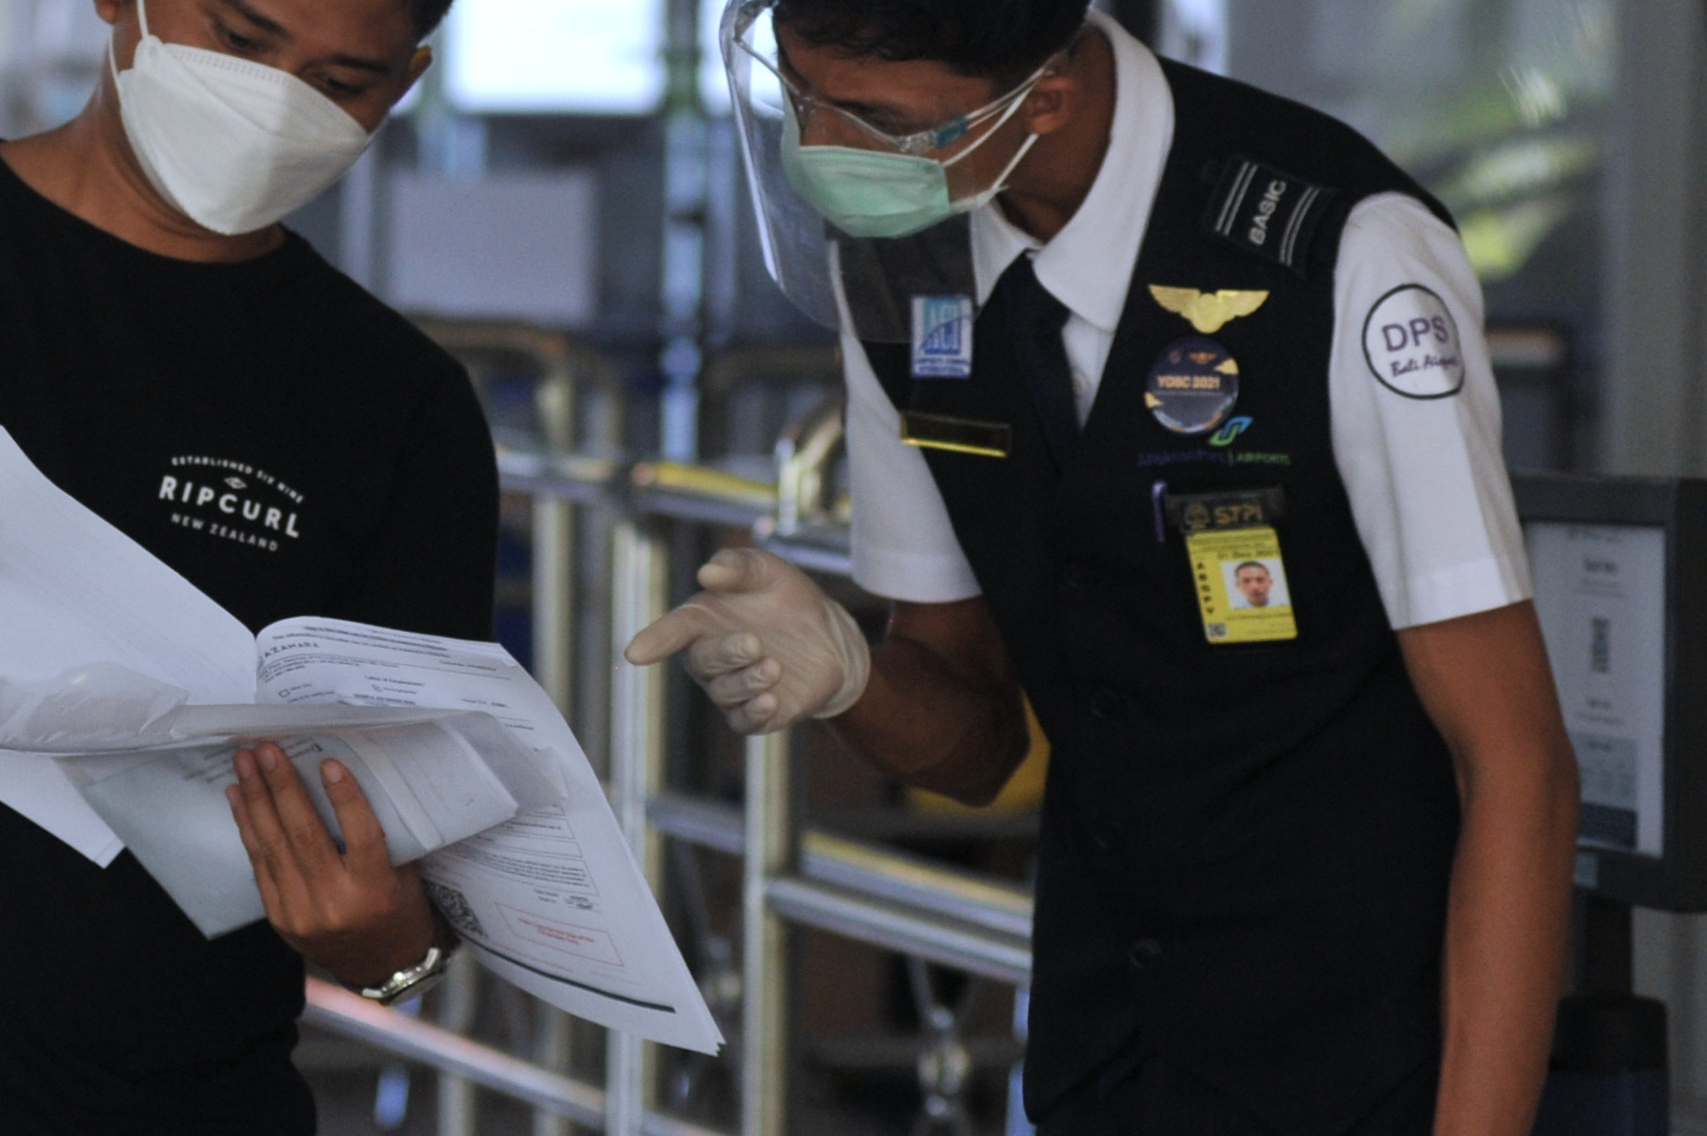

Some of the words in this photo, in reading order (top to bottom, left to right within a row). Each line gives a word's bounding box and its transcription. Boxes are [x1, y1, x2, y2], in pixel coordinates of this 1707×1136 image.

[1249, 180, 1287, 245] BASIC
[1382, 315, 1449, 352] DPS
[171, 456, 253, 475] ESTABLISHED
[256, 470, 275, 485] SIX
[277, 481, 304, 504] NINE
[171, 513, 204, 530] NEW
[209, 523, 279, 552] ZEALAND
[264, 641, 321, 659] AZAMARA
